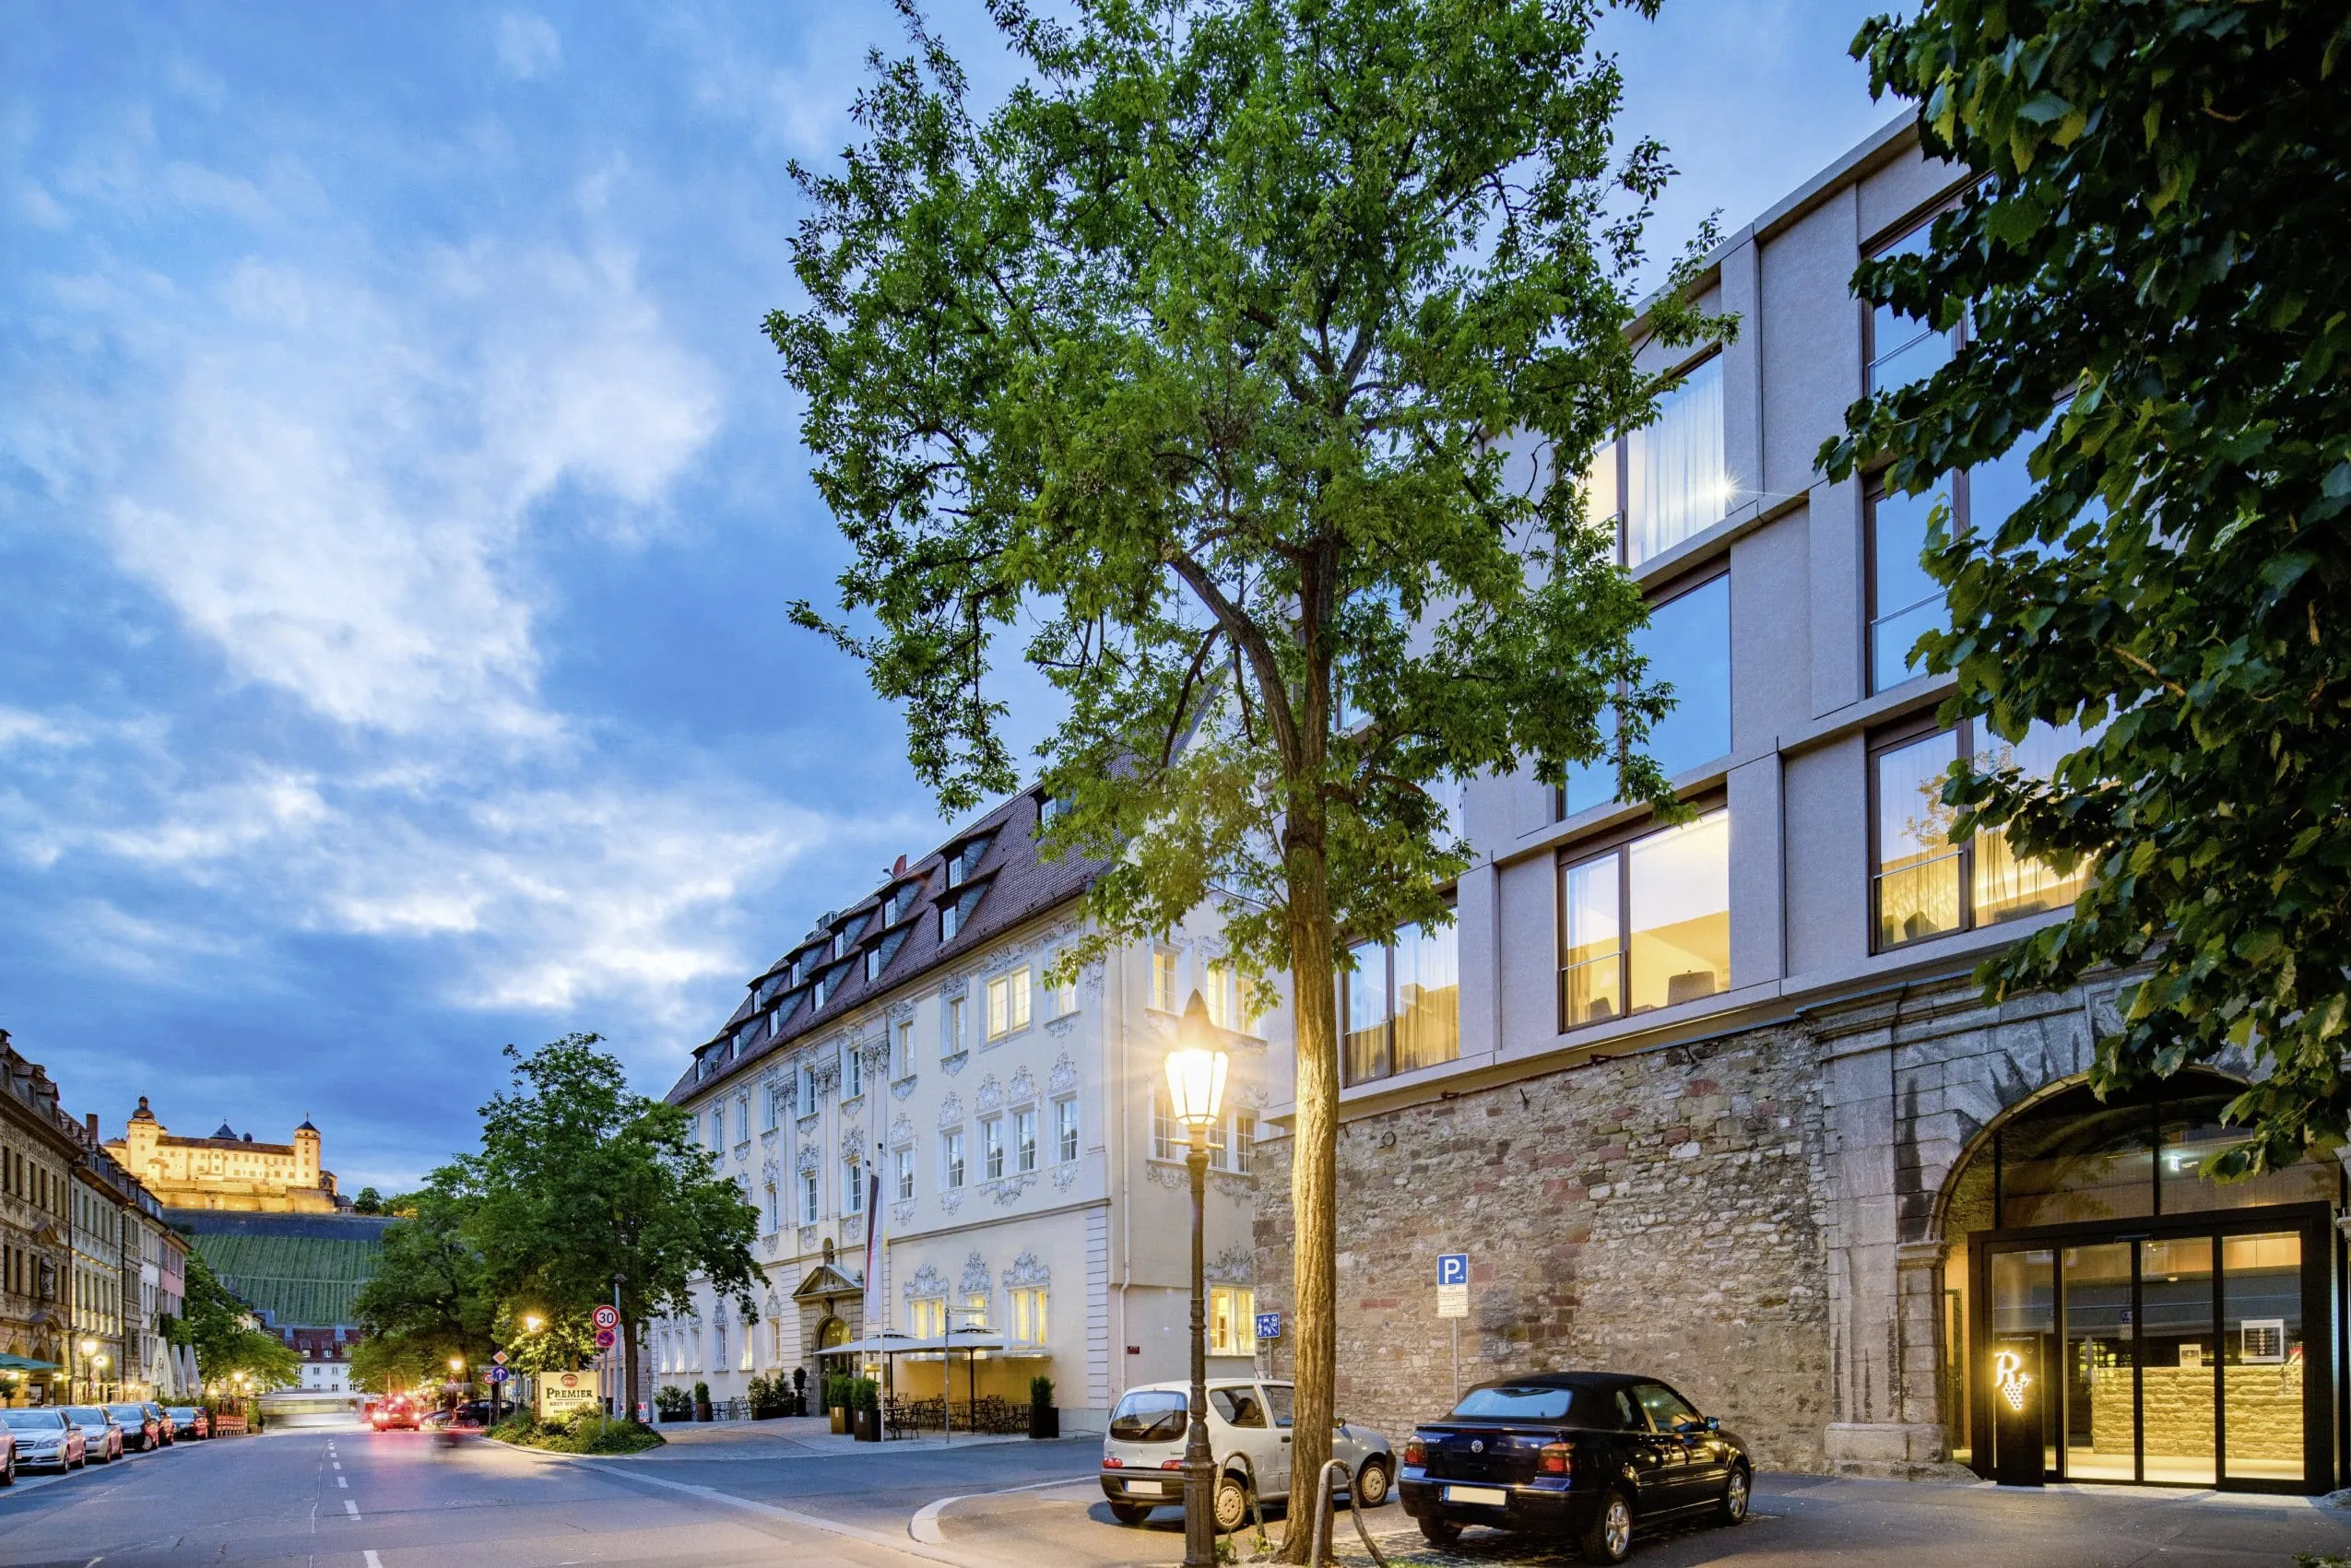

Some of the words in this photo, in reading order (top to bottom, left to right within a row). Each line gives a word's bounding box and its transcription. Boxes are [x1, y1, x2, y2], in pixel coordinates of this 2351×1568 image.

[1444, 1258, 1460, 1284] P
[598, 1312, 614, 1324] 30
[546, 1387, 593, 1398] PREMIER
